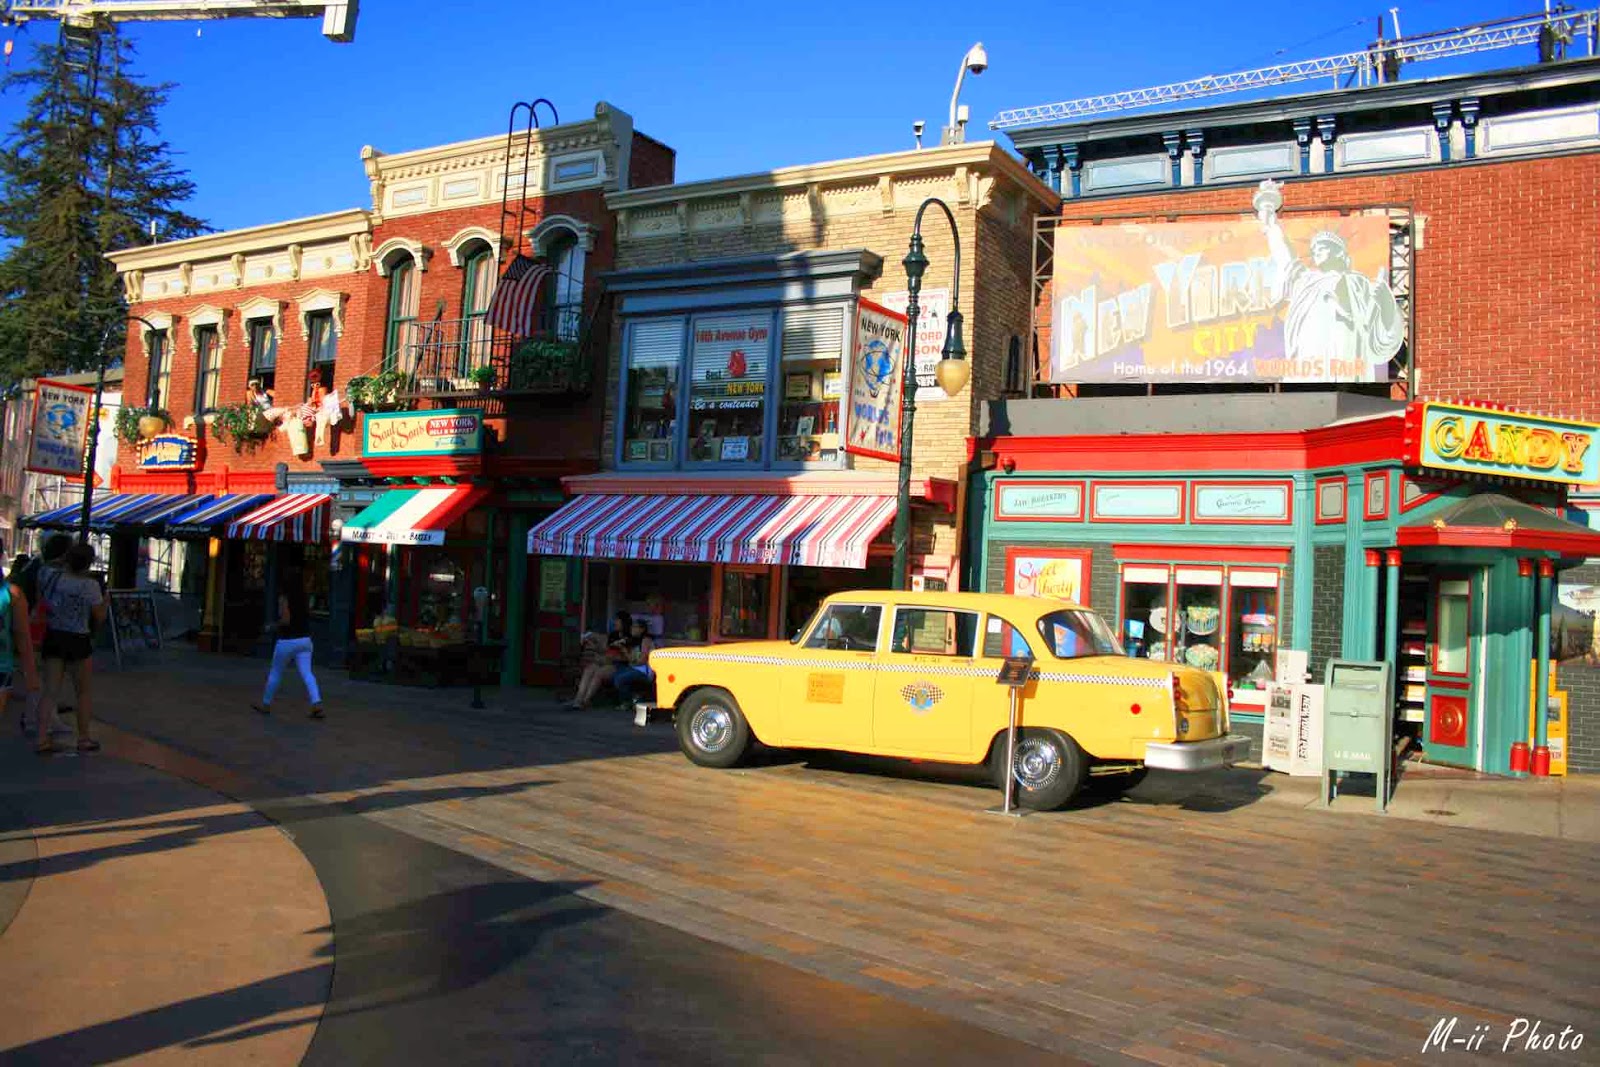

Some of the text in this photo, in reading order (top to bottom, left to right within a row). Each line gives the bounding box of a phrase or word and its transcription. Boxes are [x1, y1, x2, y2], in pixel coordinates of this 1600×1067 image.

[860, 318, 901, 342] NEW YORK
[1193, 322, 1259, 356] CITY
[1113, 361, 1155, 376] Home
[1160, 358, 1176, 375] of
[1179, 358, 1204, 375] the
[1205, 359, 1249, 377] 1964
[1330, 357, 1366, 377] FAIR
[41, 388, 85, 405] NEW YORK
[727, 381, 764, 396] NEW YORK
[430, 417, 474, 429] NEW YORK
[1430, 416, 1591, 474] CANDY
[741, 548, 778, 560] CANDY
